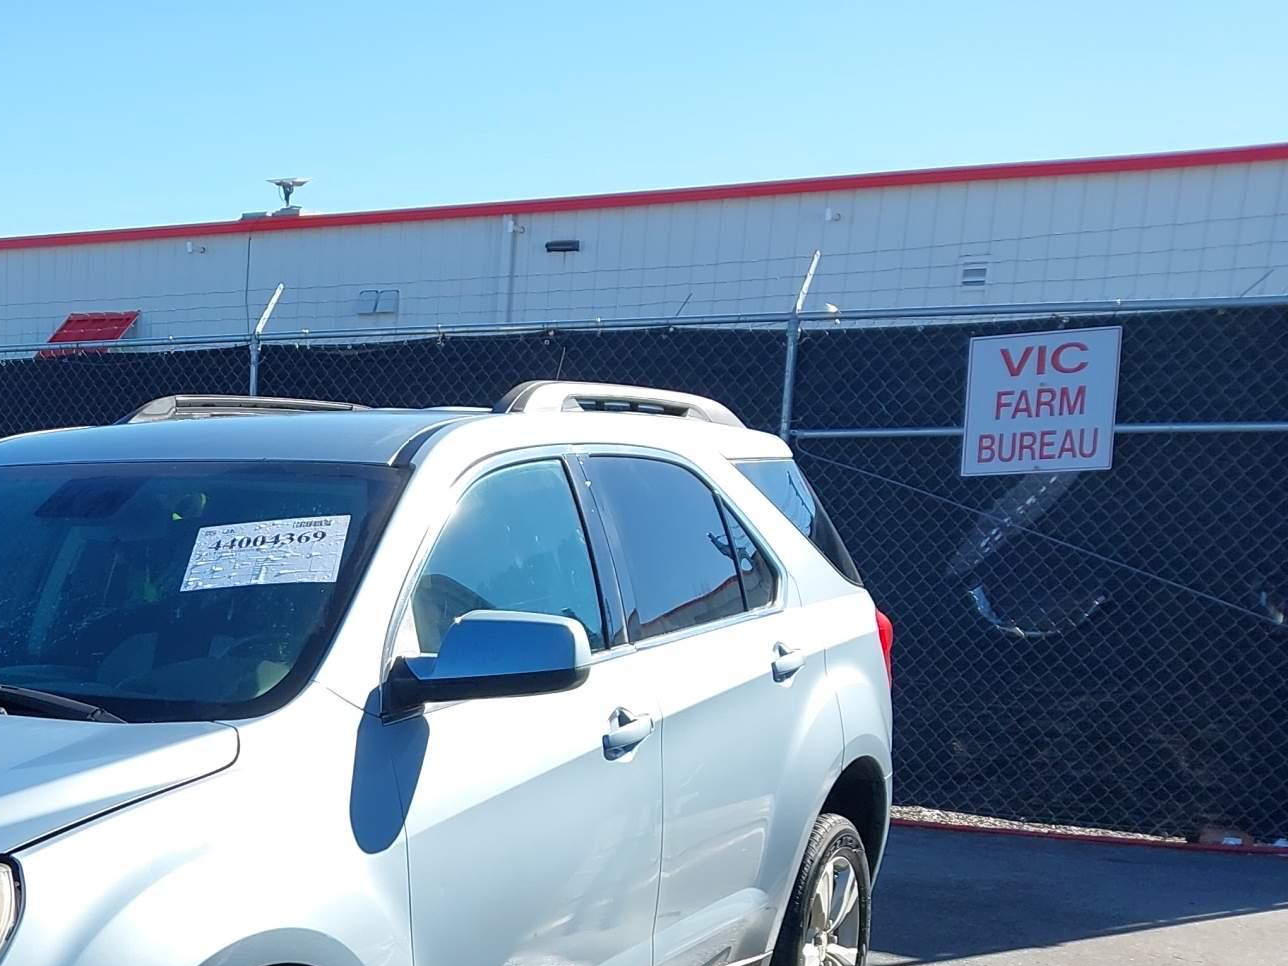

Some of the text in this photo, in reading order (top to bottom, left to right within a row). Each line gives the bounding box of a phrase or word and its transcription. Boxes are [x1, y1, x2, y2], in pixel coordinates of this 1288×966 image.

[999, 341, 1089, 377] VIC
[994, 385, 1087, 421] FARM
[977, 427, 1099, 464] BUREAU
[207, 530, 328, 551] 44004369
